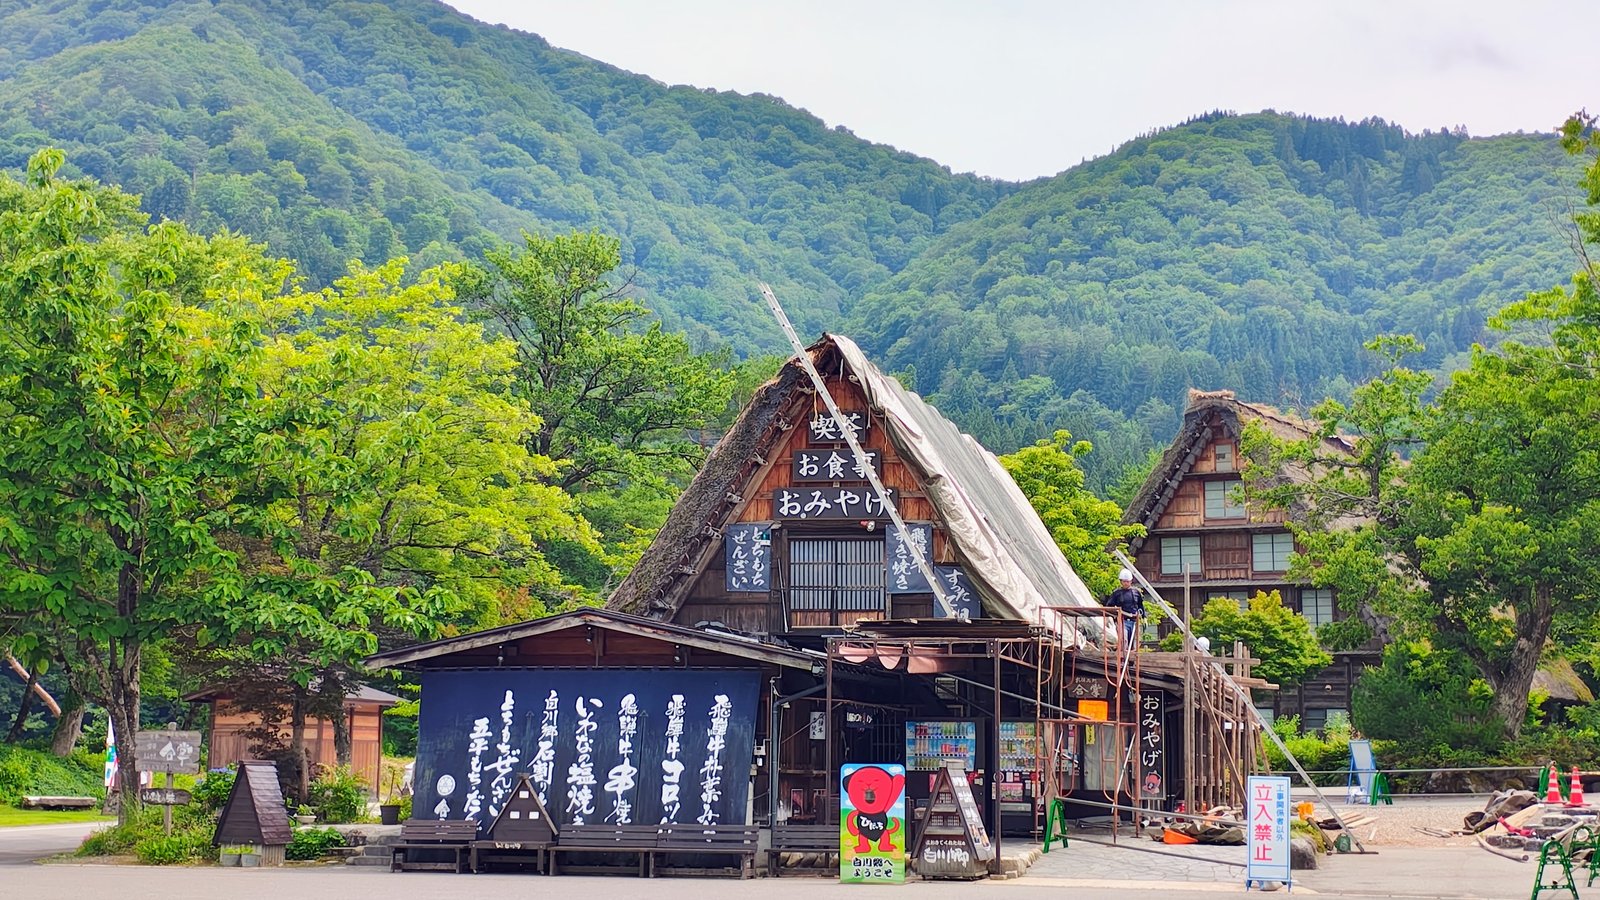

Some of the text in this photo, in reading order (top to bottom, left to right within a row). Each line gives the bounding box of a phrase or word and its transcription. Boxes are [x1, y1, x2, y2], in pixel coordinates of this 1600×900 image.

[799, 451, 876, 479] お食事
[778, 487, 893, 517] おみやげ
[731, 530, 749, 589] ぜんざい
[751, 526, 765, 586] とちもち
[892, 531, 912, 590] すき焼き
[1142, 695, 1162, 767] おみやげ
[1254, 784, 1273, 861] 立入禁止
[1276, 784, 1285, 842] 工事関係者以外
[853, 857, 893, 867] 白川郷へ
[853, 868, 893, 878] ようこそ
